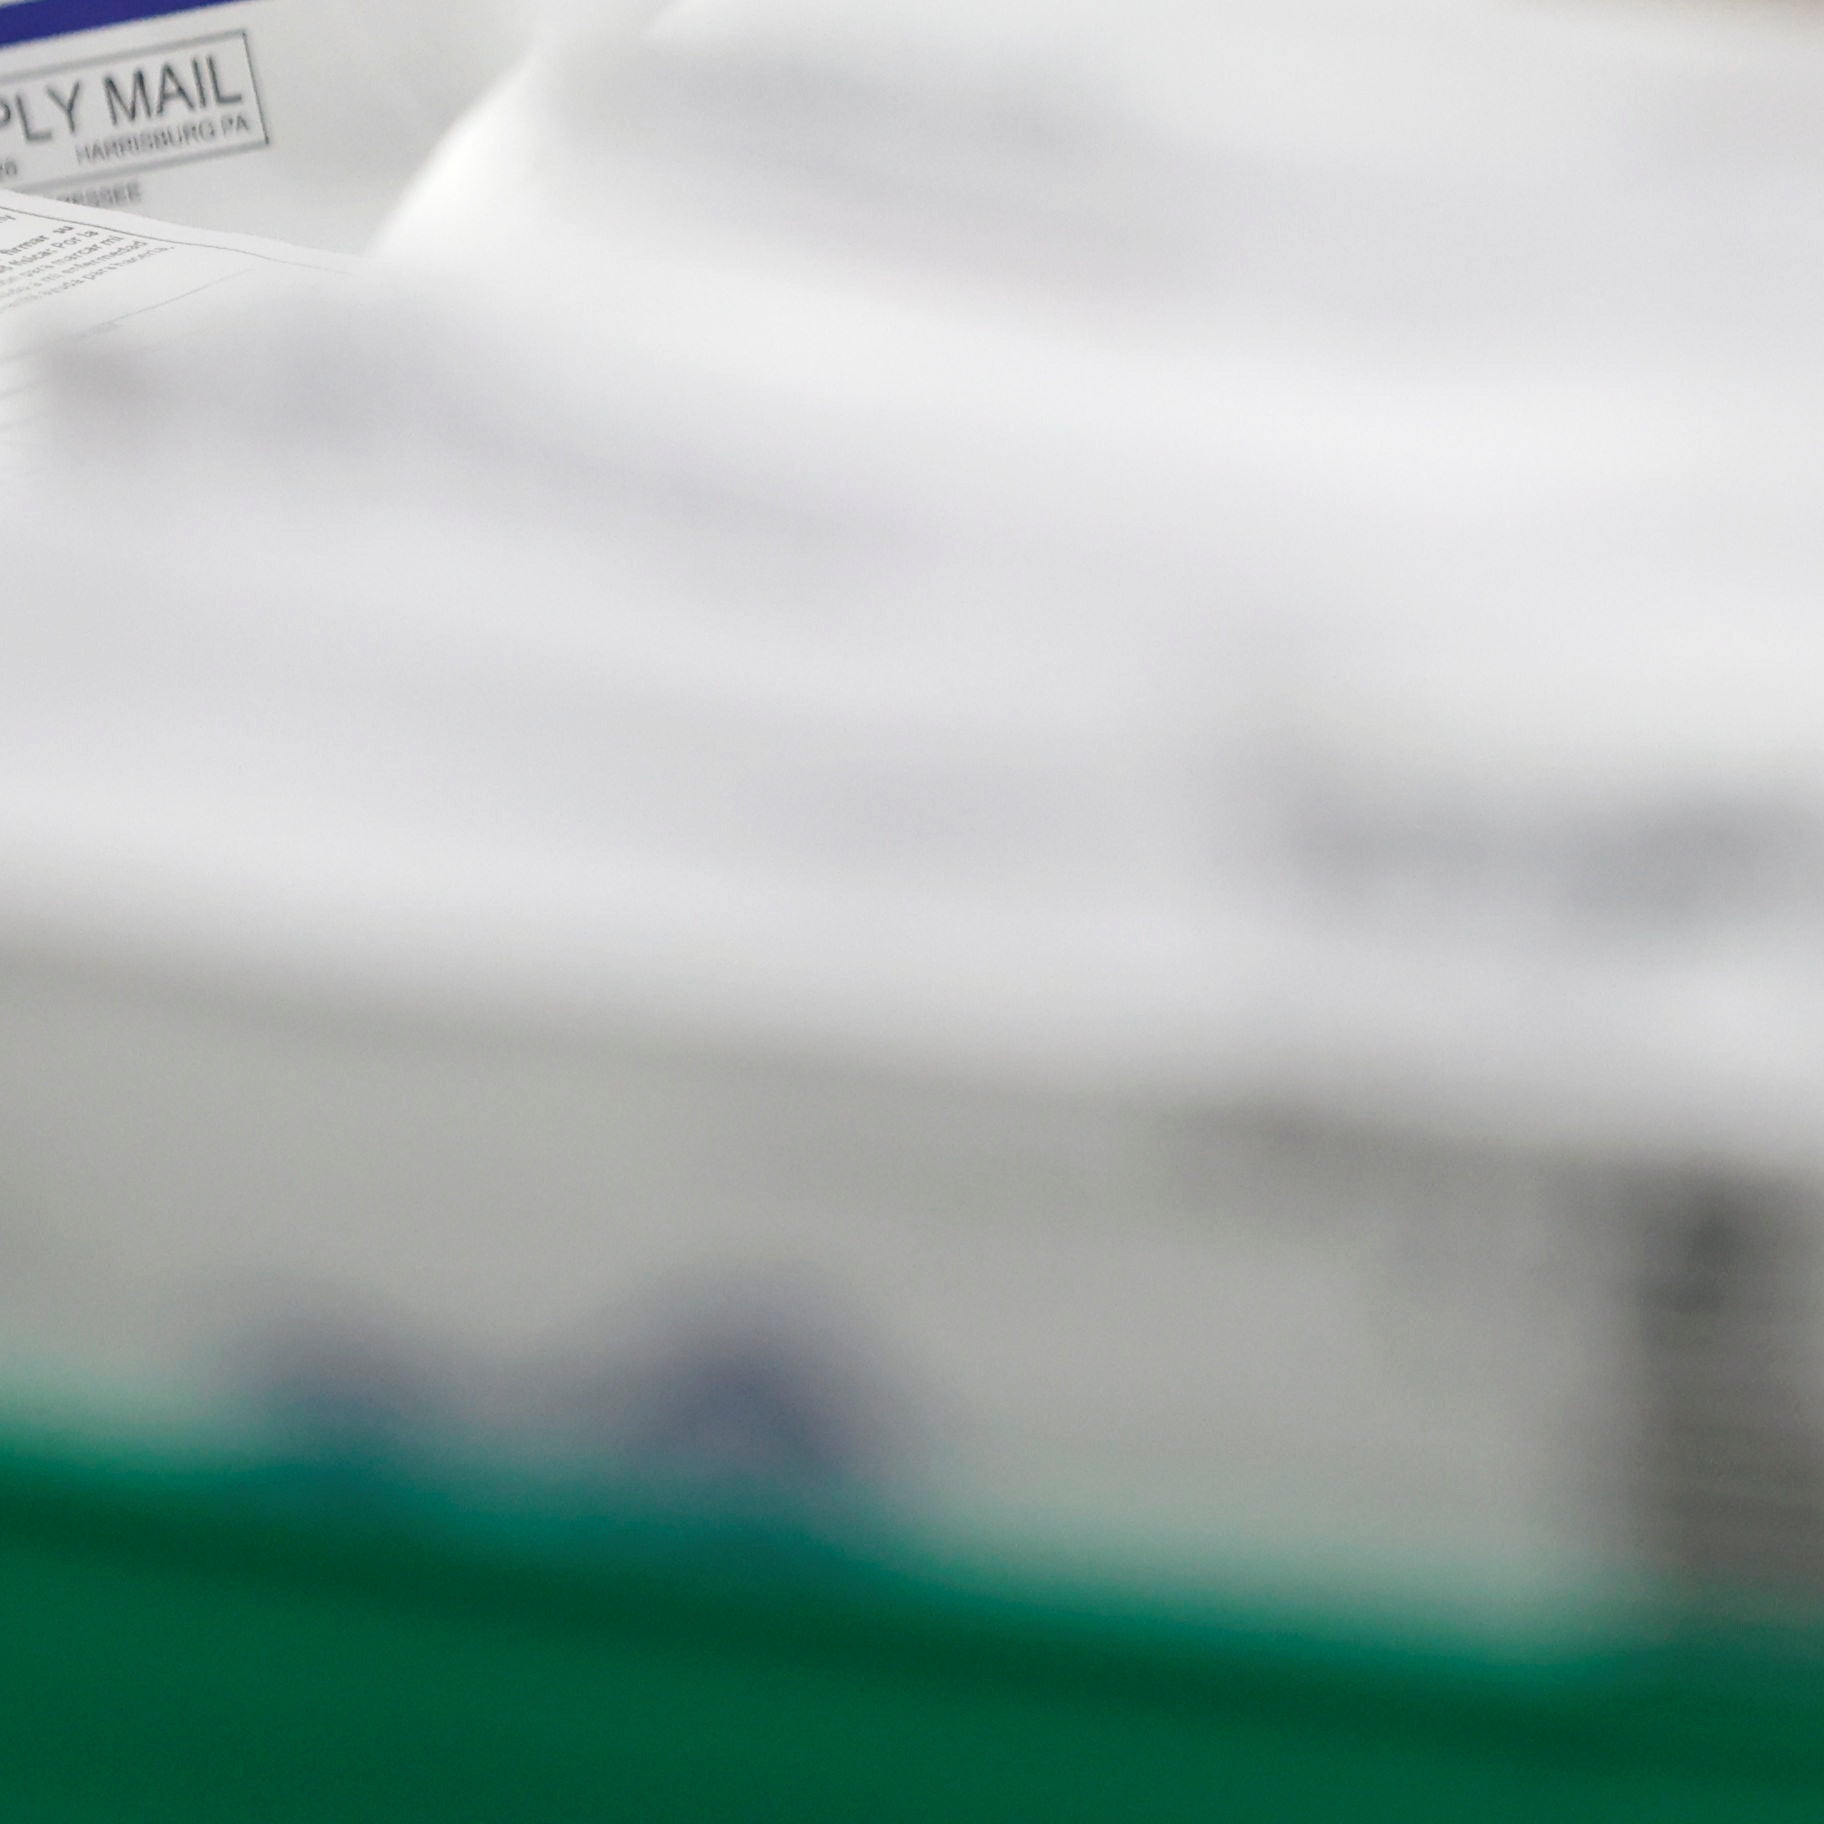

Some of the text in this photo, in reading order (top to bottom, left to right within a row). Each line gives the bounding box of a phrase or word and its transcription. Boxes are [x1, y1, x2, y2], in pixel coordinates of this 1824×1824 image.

[105, 53, 244, 126] MAIL
[76, 114, 251, 165] HARRISBURG PA
[50, 236, 82, 249] Por
[52, 225, 75, 234] su
